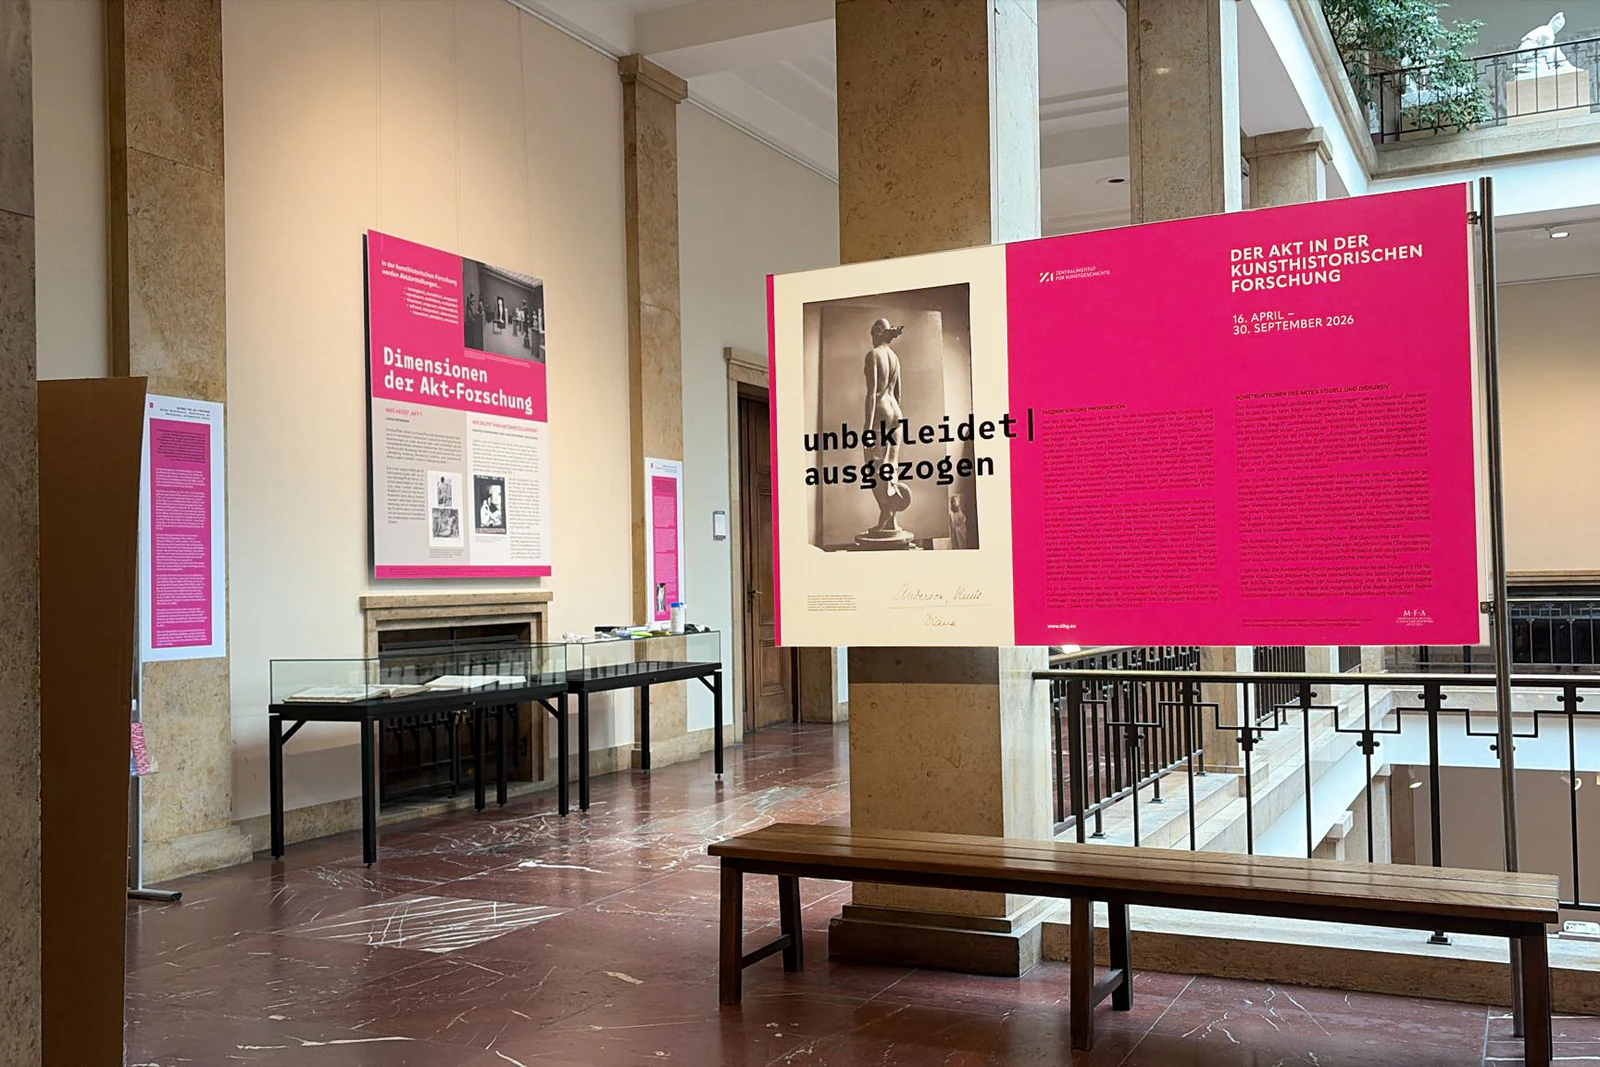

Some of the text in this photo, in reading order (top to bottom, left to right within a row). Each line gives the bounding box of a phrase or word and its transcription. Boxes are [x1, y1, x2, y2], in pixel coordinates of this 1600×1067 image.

[1230, 234, 1369, 262] DER AKT IN DER
[1231, 244, 1423, 277] KUNSTHISTORISCHEN
[1231, 269, 1341, 293] FORSCHUNG
[1232, 313, 1248, 325] 16.
[1250, 310, 1285, 323] APRIL
[1233, 314, 1354, 335] 30. SEPTEMBER 2026
[383, 346, 488, 383] Dimensionen
[384, 370, 533, 415] der Akt-Forschung
[803, 412, 1017, 452] unbekleidet
[804, 455, 994, 490] ausgezogen
